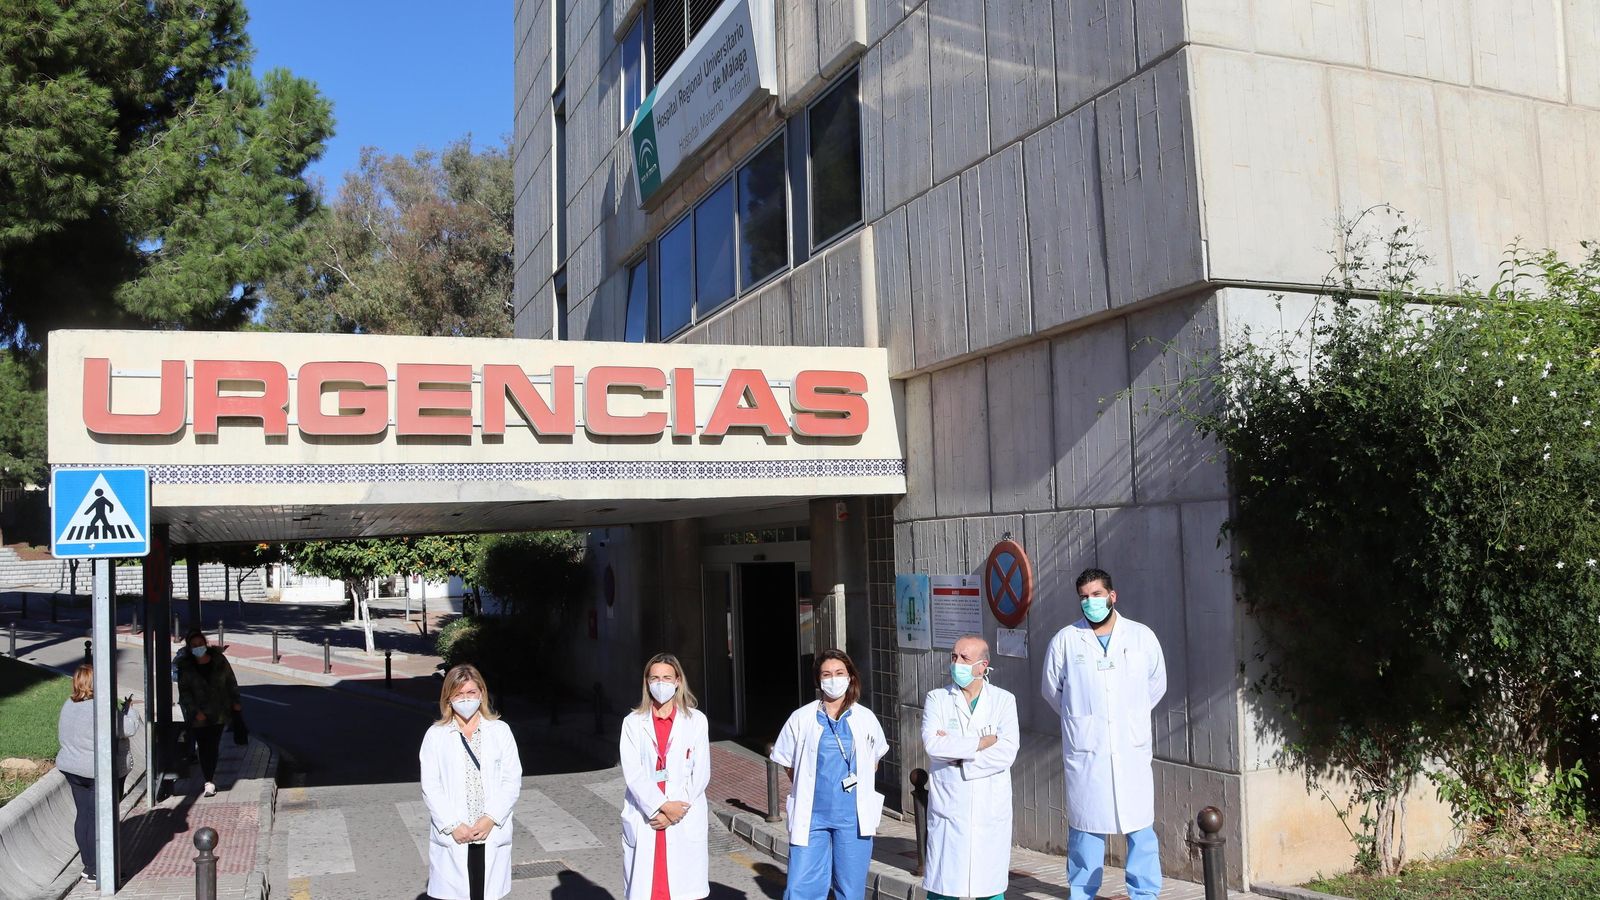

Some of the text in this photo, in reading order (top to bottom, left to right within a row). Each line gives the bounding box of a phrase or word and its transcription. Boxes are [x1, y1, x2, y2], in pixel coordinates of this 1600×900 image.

[656, 24, 744, 132] Hospital Regional Universitario
[678, 122, 700, 152] Hospital
[700, 98, 724, 130] Materno
[729, 67, 752, 99] Infantil
[712, 48, 748, 94] de Málaga
[82, 357, 870, 439] URGENCIAS
